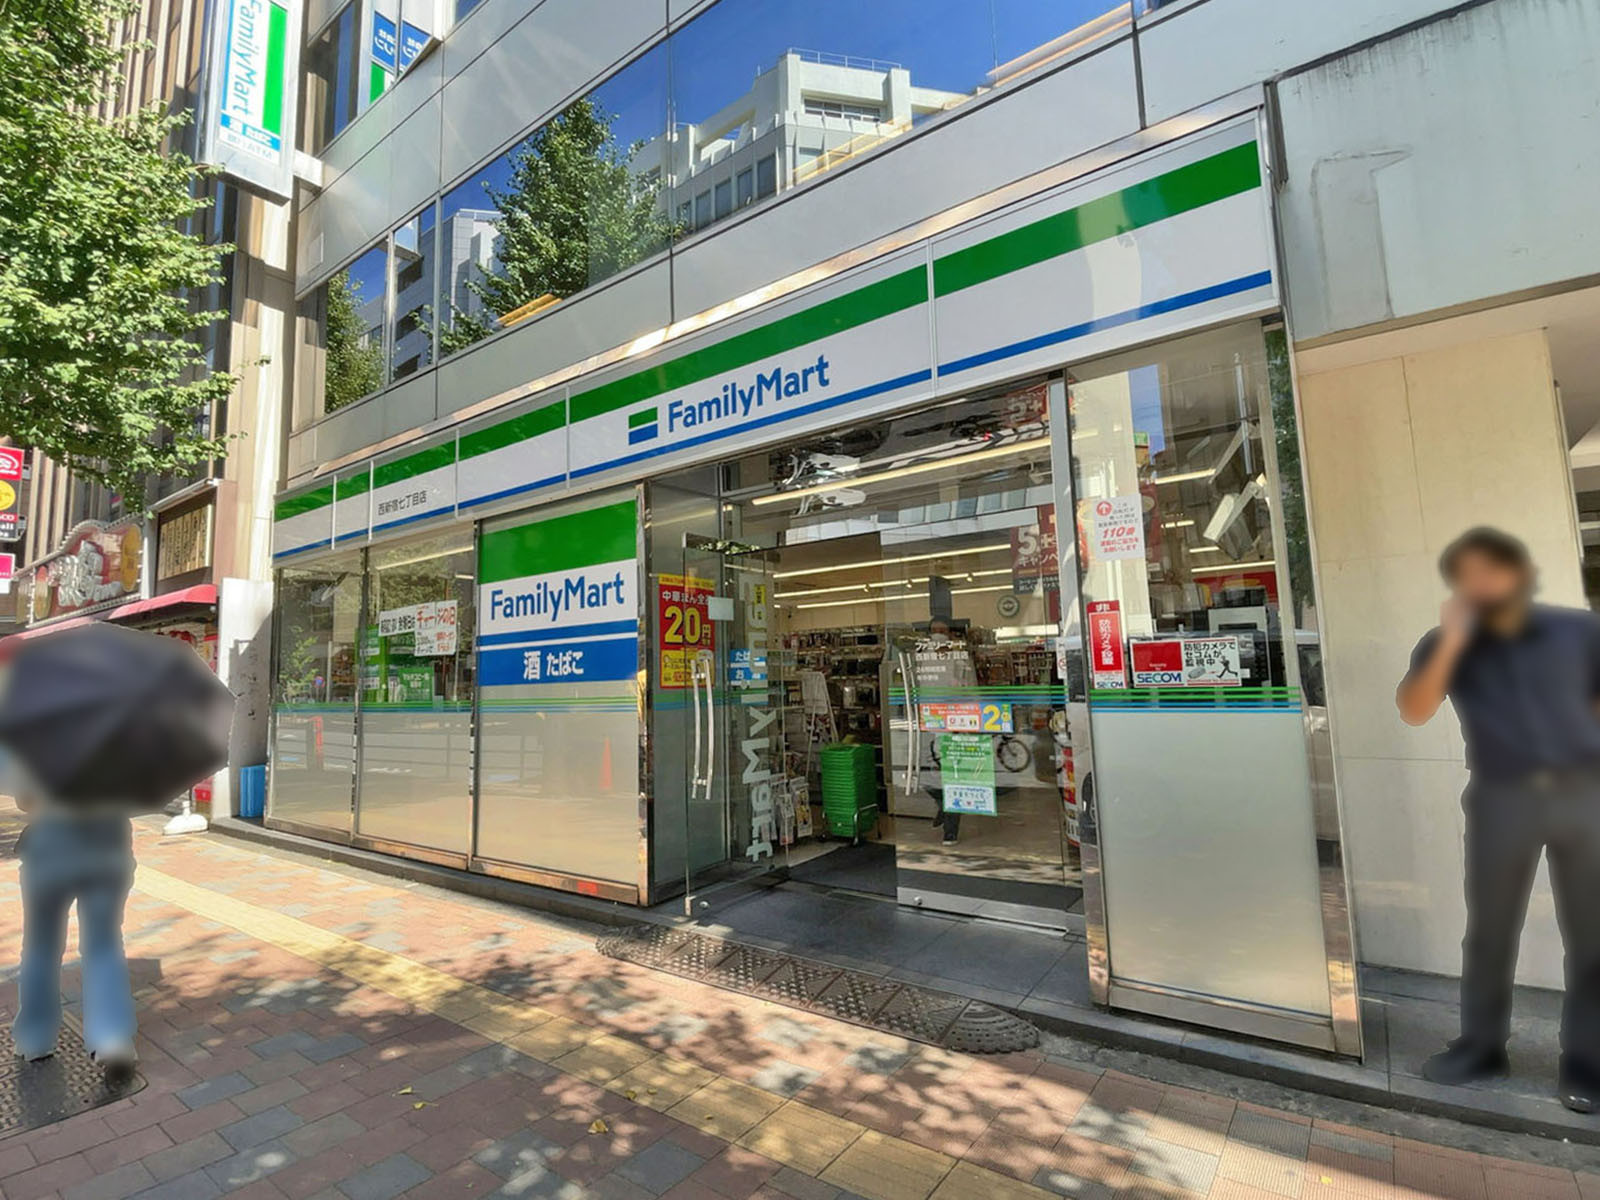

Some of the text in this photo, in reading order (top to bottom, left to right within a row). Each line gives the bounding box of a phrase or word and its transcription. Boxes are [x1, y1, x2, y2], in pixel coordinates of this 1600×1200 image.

[668, 354, 830, 433] FamilyMart
[491, 572, 625, 622] FamilyMart
[1184, 642, 1236, 651] 防犯カメラで
[1185, 651, 1222, 659] セコムが
[523, 650, 584, 680] 酒 たばこ
[1185, 658, 1215, 667] 監視中
[1137, 672, 1182, 683] SECOM
